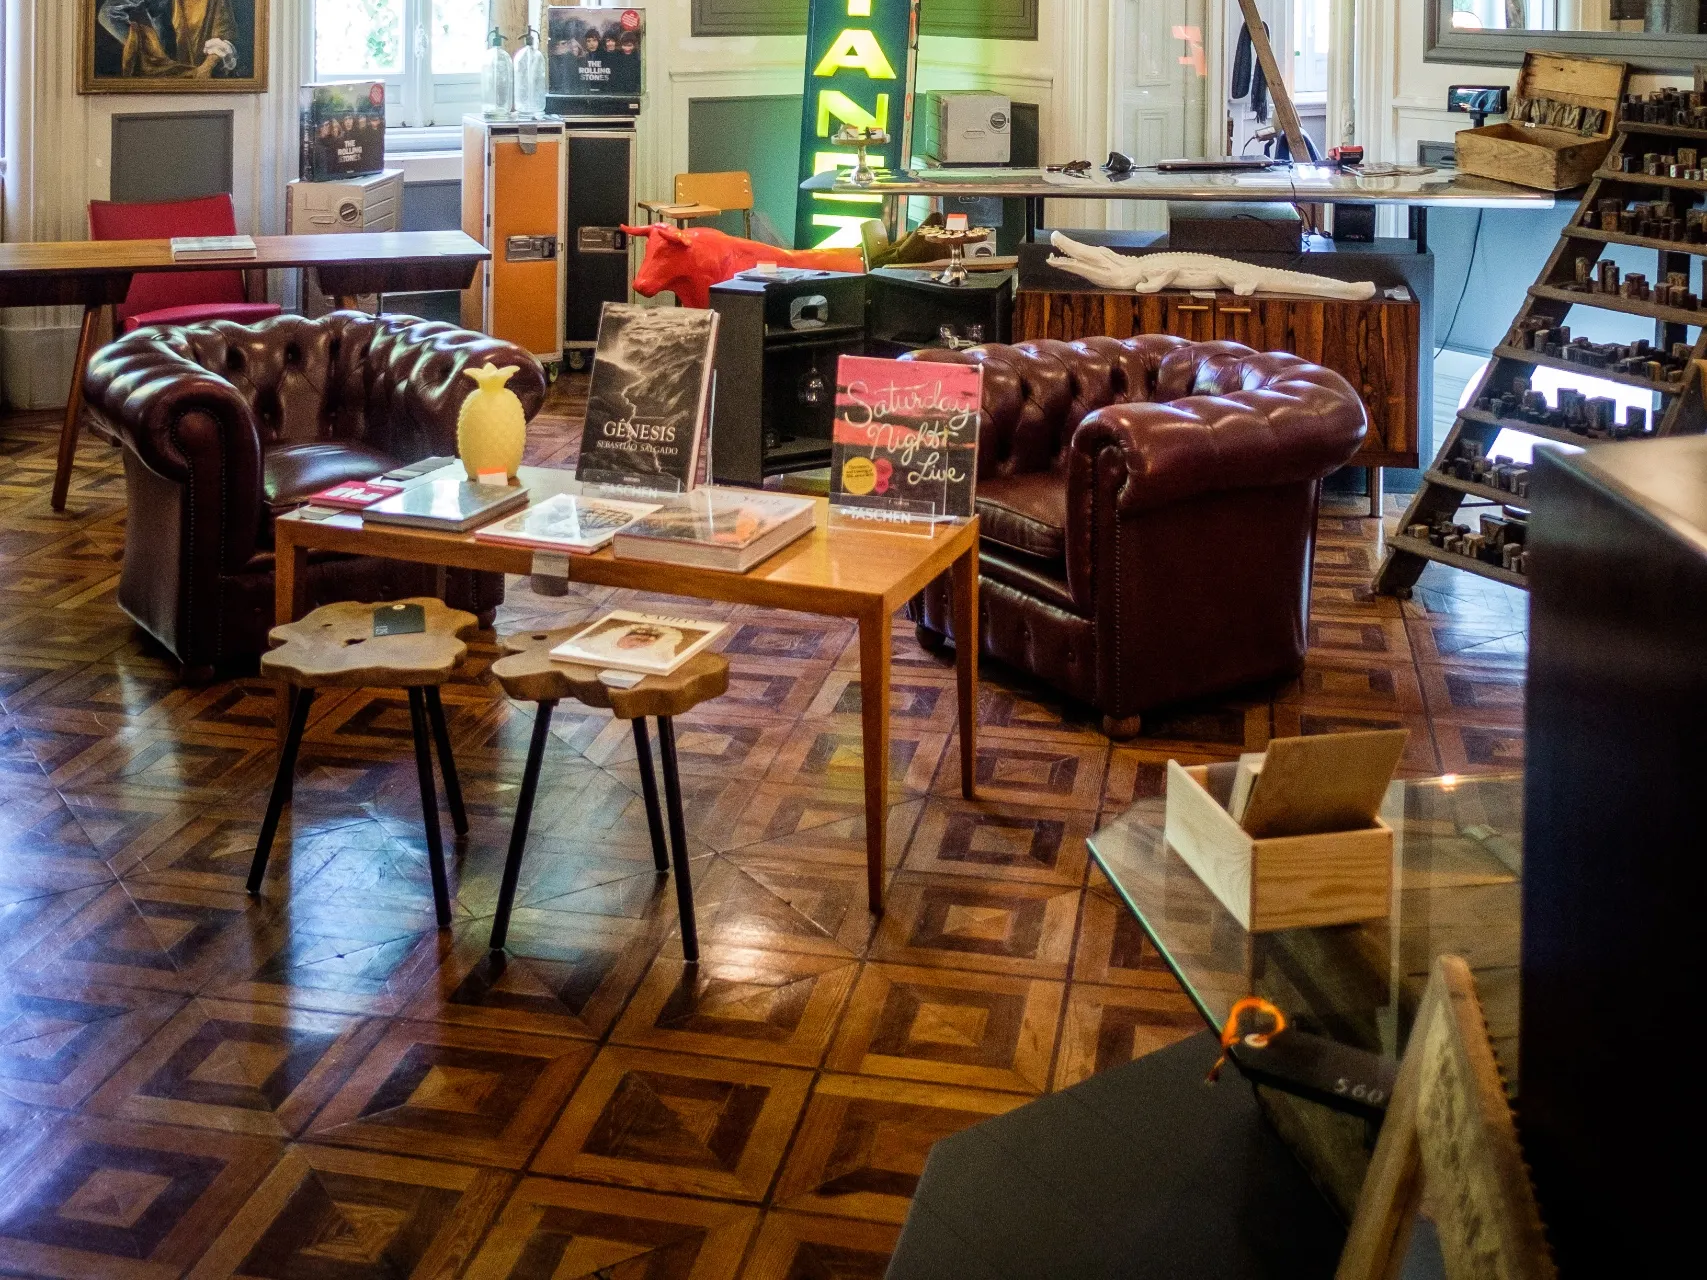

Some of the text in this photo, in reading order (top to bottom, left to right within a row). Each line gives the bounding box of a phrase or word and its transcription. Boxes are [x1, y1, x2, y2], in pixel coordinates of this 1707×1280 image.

[587, 60, 602, 68] THE
[344, 139, 356, 148] THE
[844, 380, 977, 430] Saturday
[602, 418, 676, 442] GÊNESIS
[640, 443, 678, 455] SALGADO
[867, 420, 959, 466] Night
[907, 451, 966, 485] Live
[851, 507, 911, 524] TASCHEN
